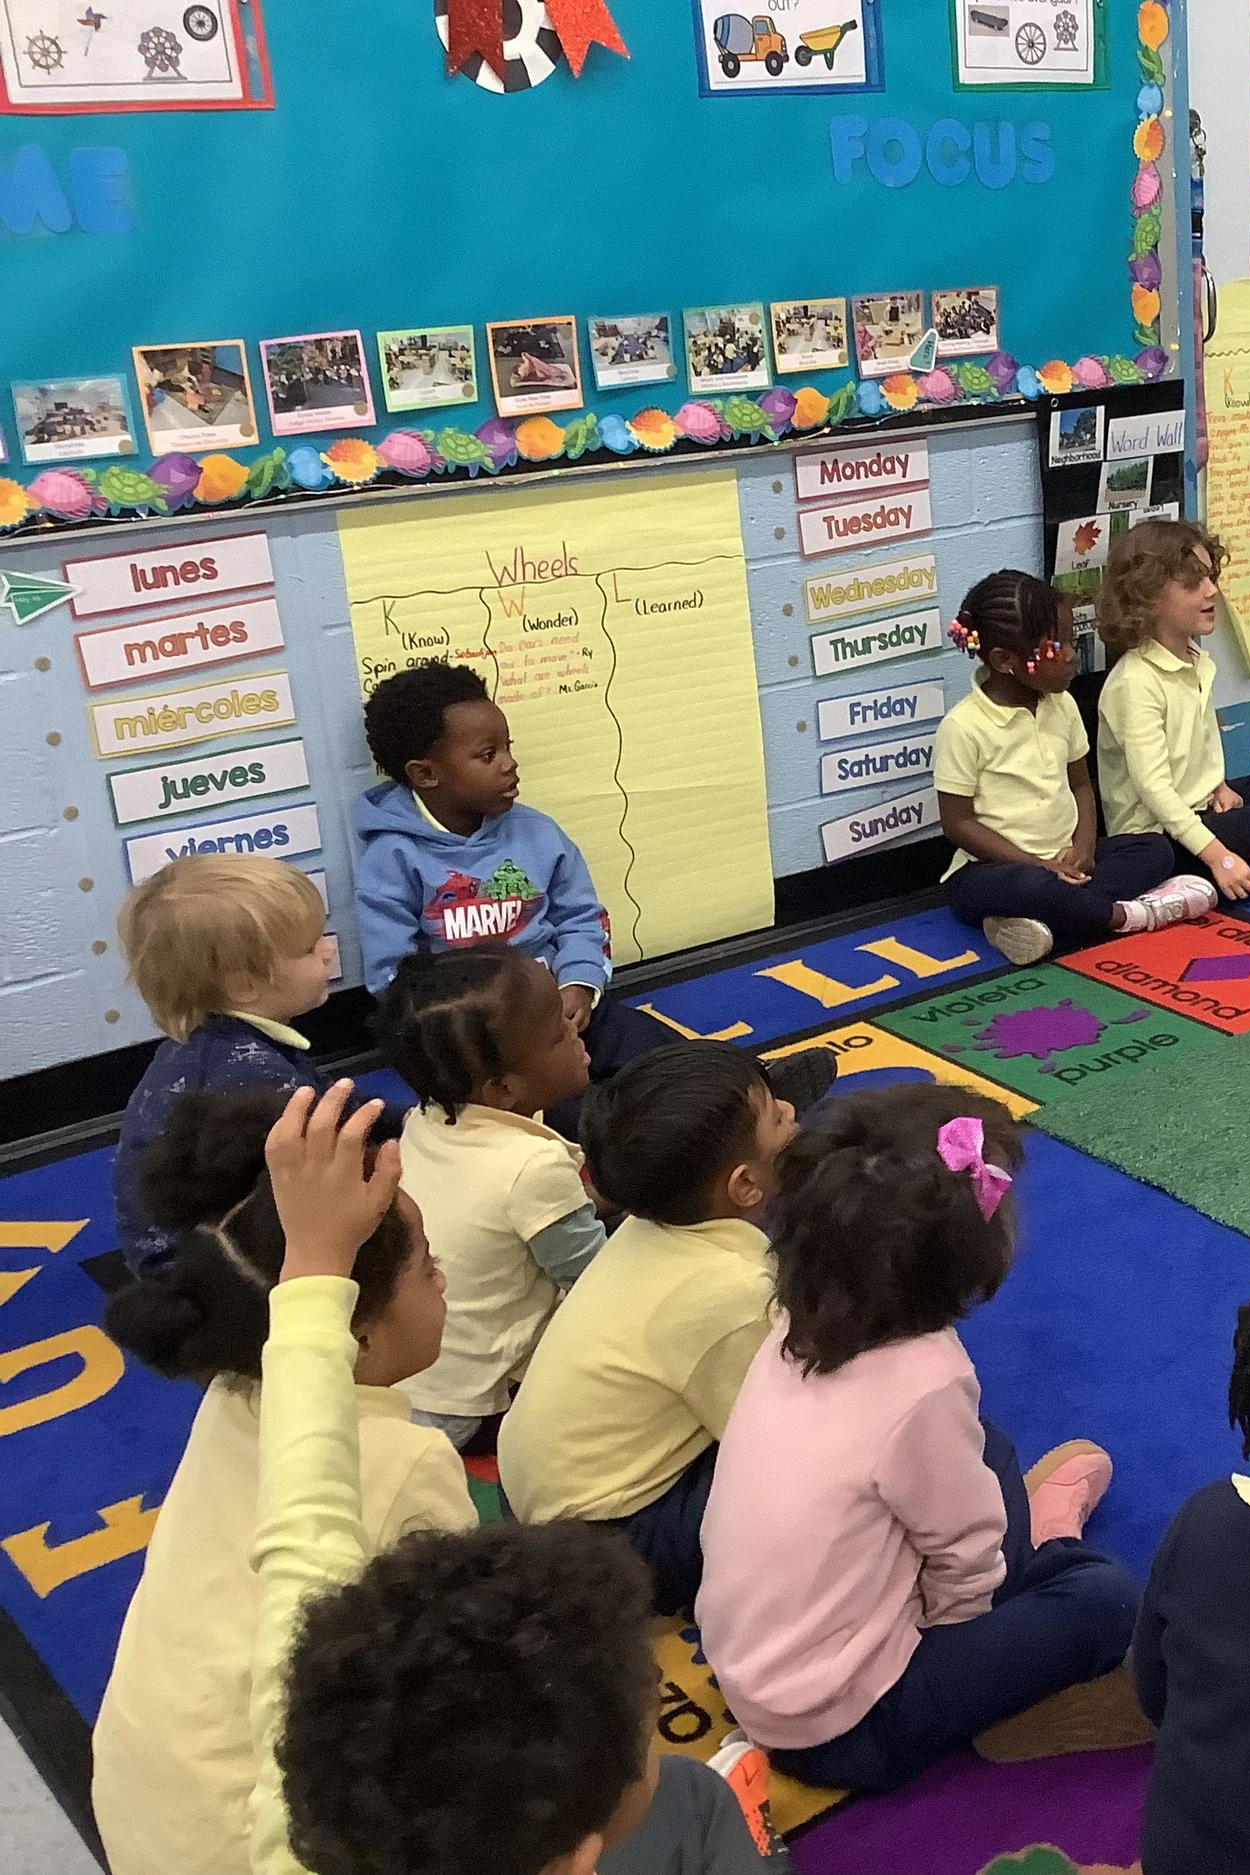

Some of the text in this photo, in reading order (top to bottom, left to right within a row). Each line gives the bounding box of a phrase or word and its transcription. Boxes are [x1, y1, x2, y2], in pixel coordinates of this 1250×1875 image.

[829, 114, 1055, 189] FOCUS
[1223, 366, 1234, 396] K
[1110, 426, 1150, 454] Word
[1156, 421, 1183, 449] Wall
[820, 452, 909, 485] Monday
[822, 505, 912, 540] Tuesday
[1107, 499, 1139, 511] Nursery
[130, 557, 219, 593] lunes
[485, 541, 580, 588] Wheels
[1071, 558, 1092, 571] Leaf
[497, 585, 526, 618] W
[613, 572, 632, 603] L
[635, 589, 704, 616] (Learned)
[810, 566, 936, 610] Wednesday
[383, 599, 400, 636] K
[523, 607, 579, 633] (Wonder)
[124, 620, 249, 667] martes
[401, 626, 450, 651] (Know)
[550, 632, 580, 646] need
[829, 622, 928, 662] Thursday
[361, 656, 397, 679] Spin
[114, 689, 280, 740] miércoles
[849, 695, 918, 726] Friday
[837, 745, 934, 781] Saturday
[158, 761, 267, 810] jueves
[849, 802, 924, 843] Sunday
[165, 823, 290, 863] viernes
[909, 976, 1047, 1024] violeta
[1053, 1031, 1180, 1087] purple
